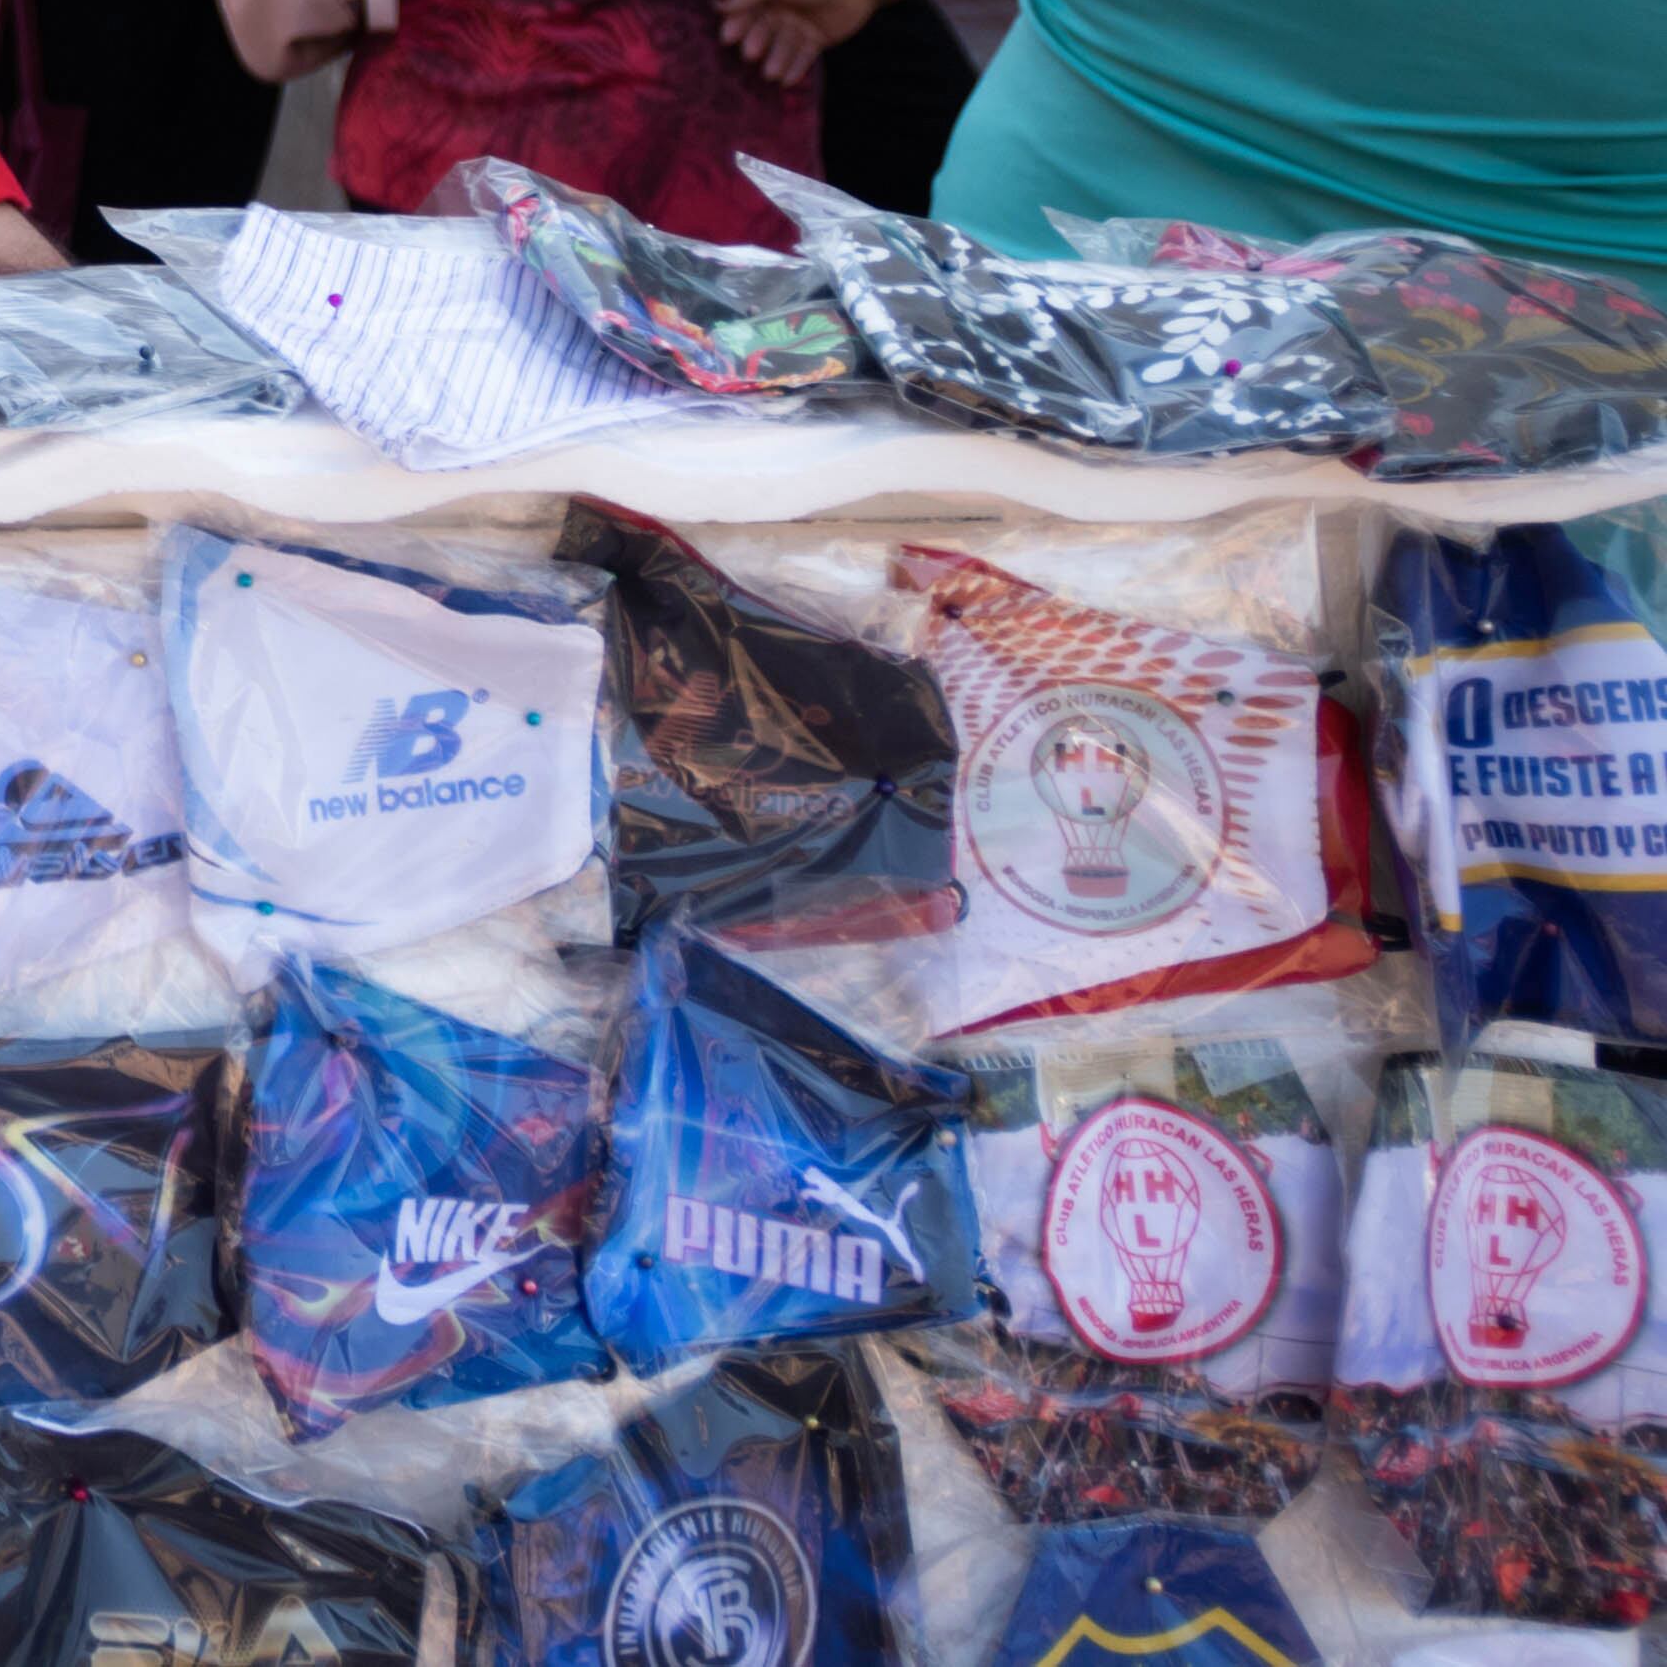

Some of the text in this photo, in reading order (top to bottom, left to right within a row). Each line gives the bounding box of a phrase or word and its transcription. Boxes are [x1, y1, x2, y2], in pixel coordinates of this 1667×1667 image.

[308, 773, 527, 823] new balance
[976, 764, 995, 813] CLUB
[1067, 692, 1158, 722] HURACAN
[1157, 718, 1188, 752] LAS
[1181, 751, 1213, 816] HERAS
[1476, 753, 1623, 797] FUISTE
[1628, 752, 1657, 795] A
[1462, 819, 1525, 851] POR
[1525, 823, 1610, 858] PUTO
[1614, 825, 1636, 857] Y
[1056, 1198, 1075, 1247] CLUB
[1115, 1112, 1204, 1152] HURACAN
[1203, 1147, 1239, 1183] LAS
[1232, 1184, 1265, 1253] HERAS
[1483, 1141, 1575, 1183] HURACAN
[1573, 1180, 1610, 1218] LAS
[1602, 1220, 1630, 1287] HERAS
[394, 1197, 530, 1264] NIKE
[662, 1192, 884, 1307] PUMA
